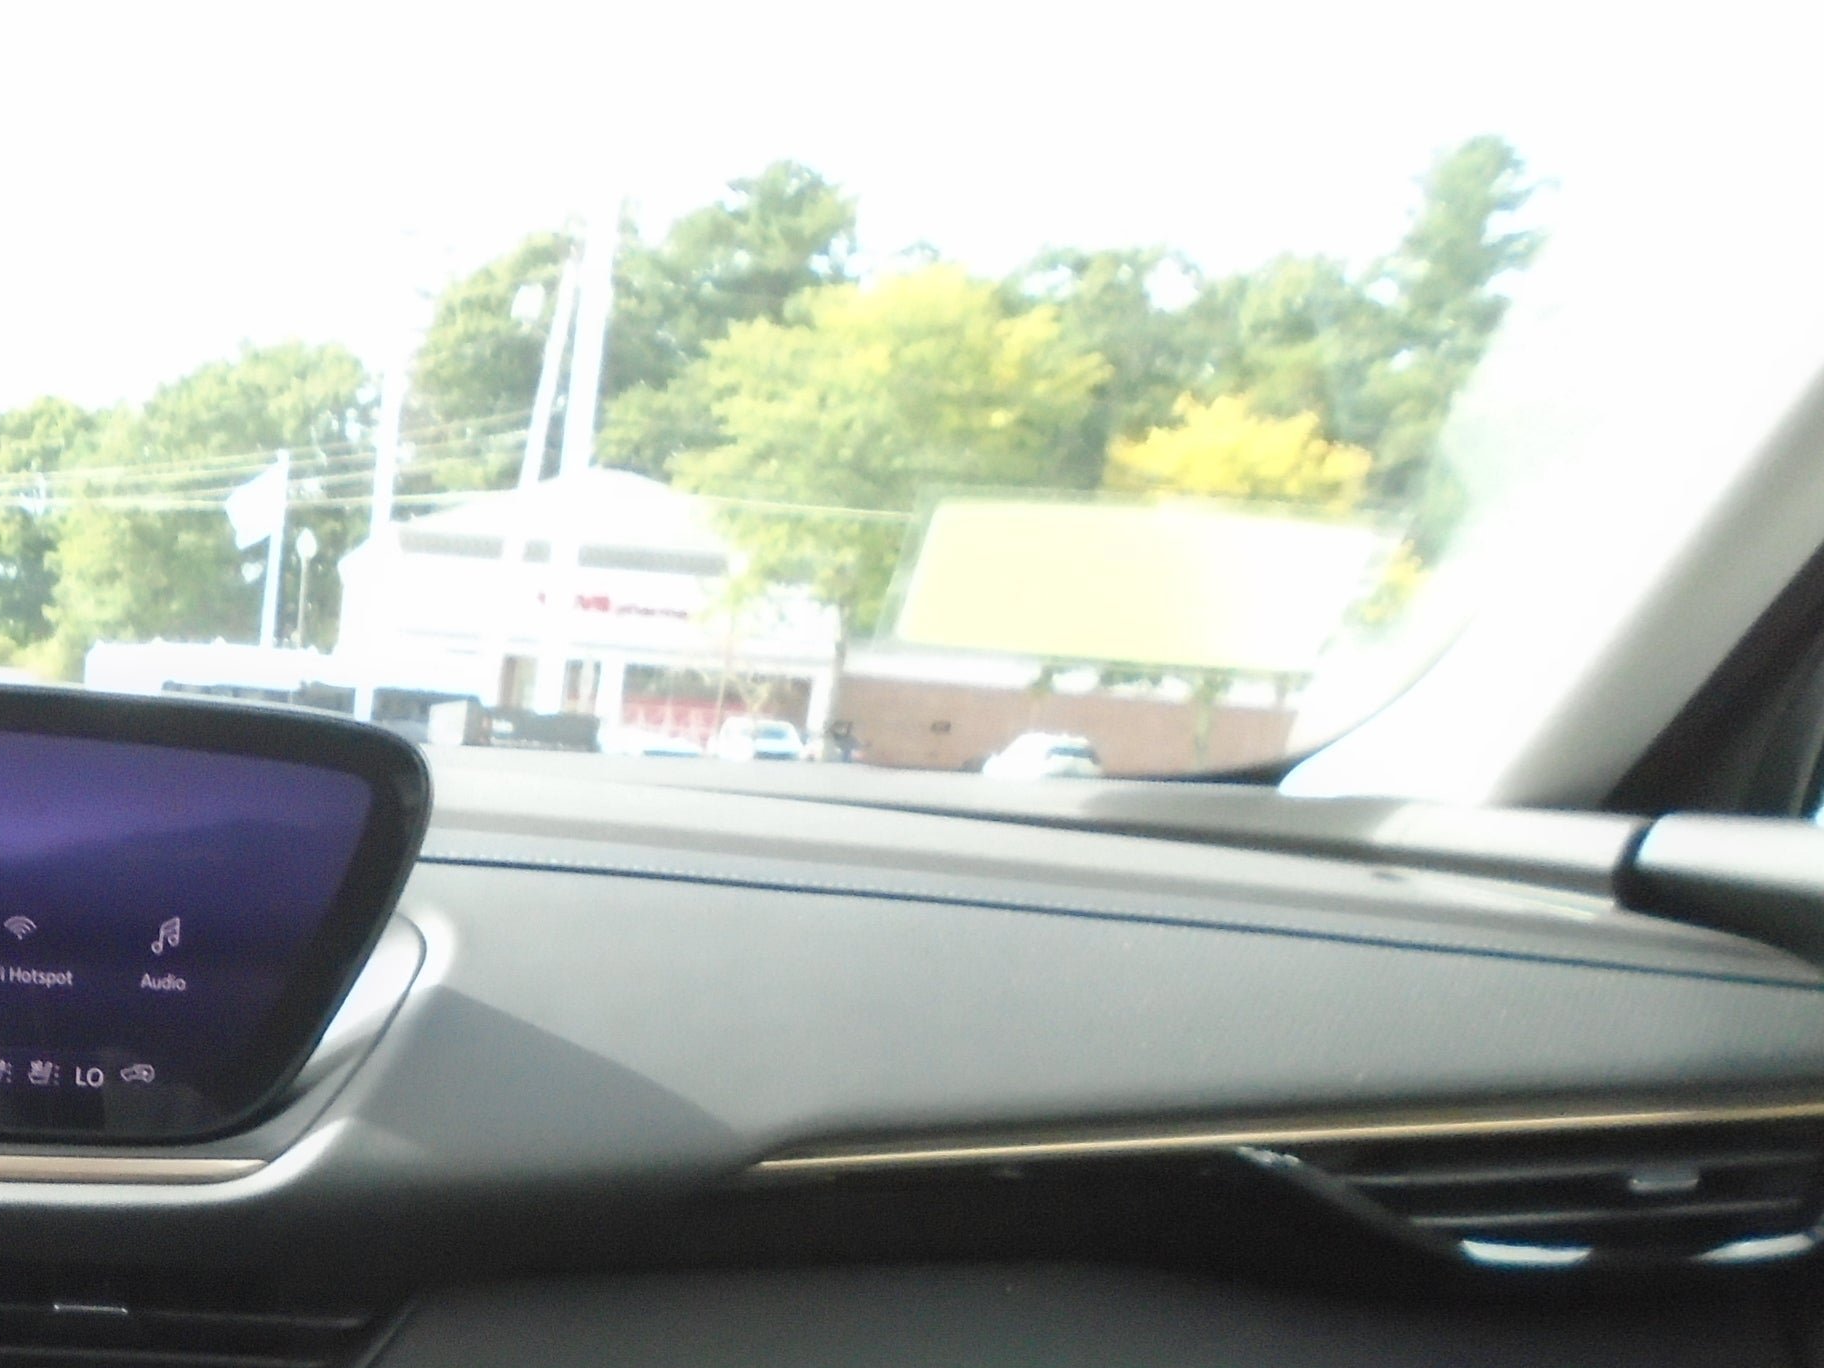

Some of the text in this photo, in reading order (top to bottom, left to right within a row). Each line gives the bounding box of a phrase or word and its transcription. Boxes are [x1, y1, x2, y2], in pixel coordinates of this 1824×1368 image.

[8, 966, 75, 989] Hotspot
[140, 972, 188, 992] Audio
[75, 1066, 105, 1088] LO
